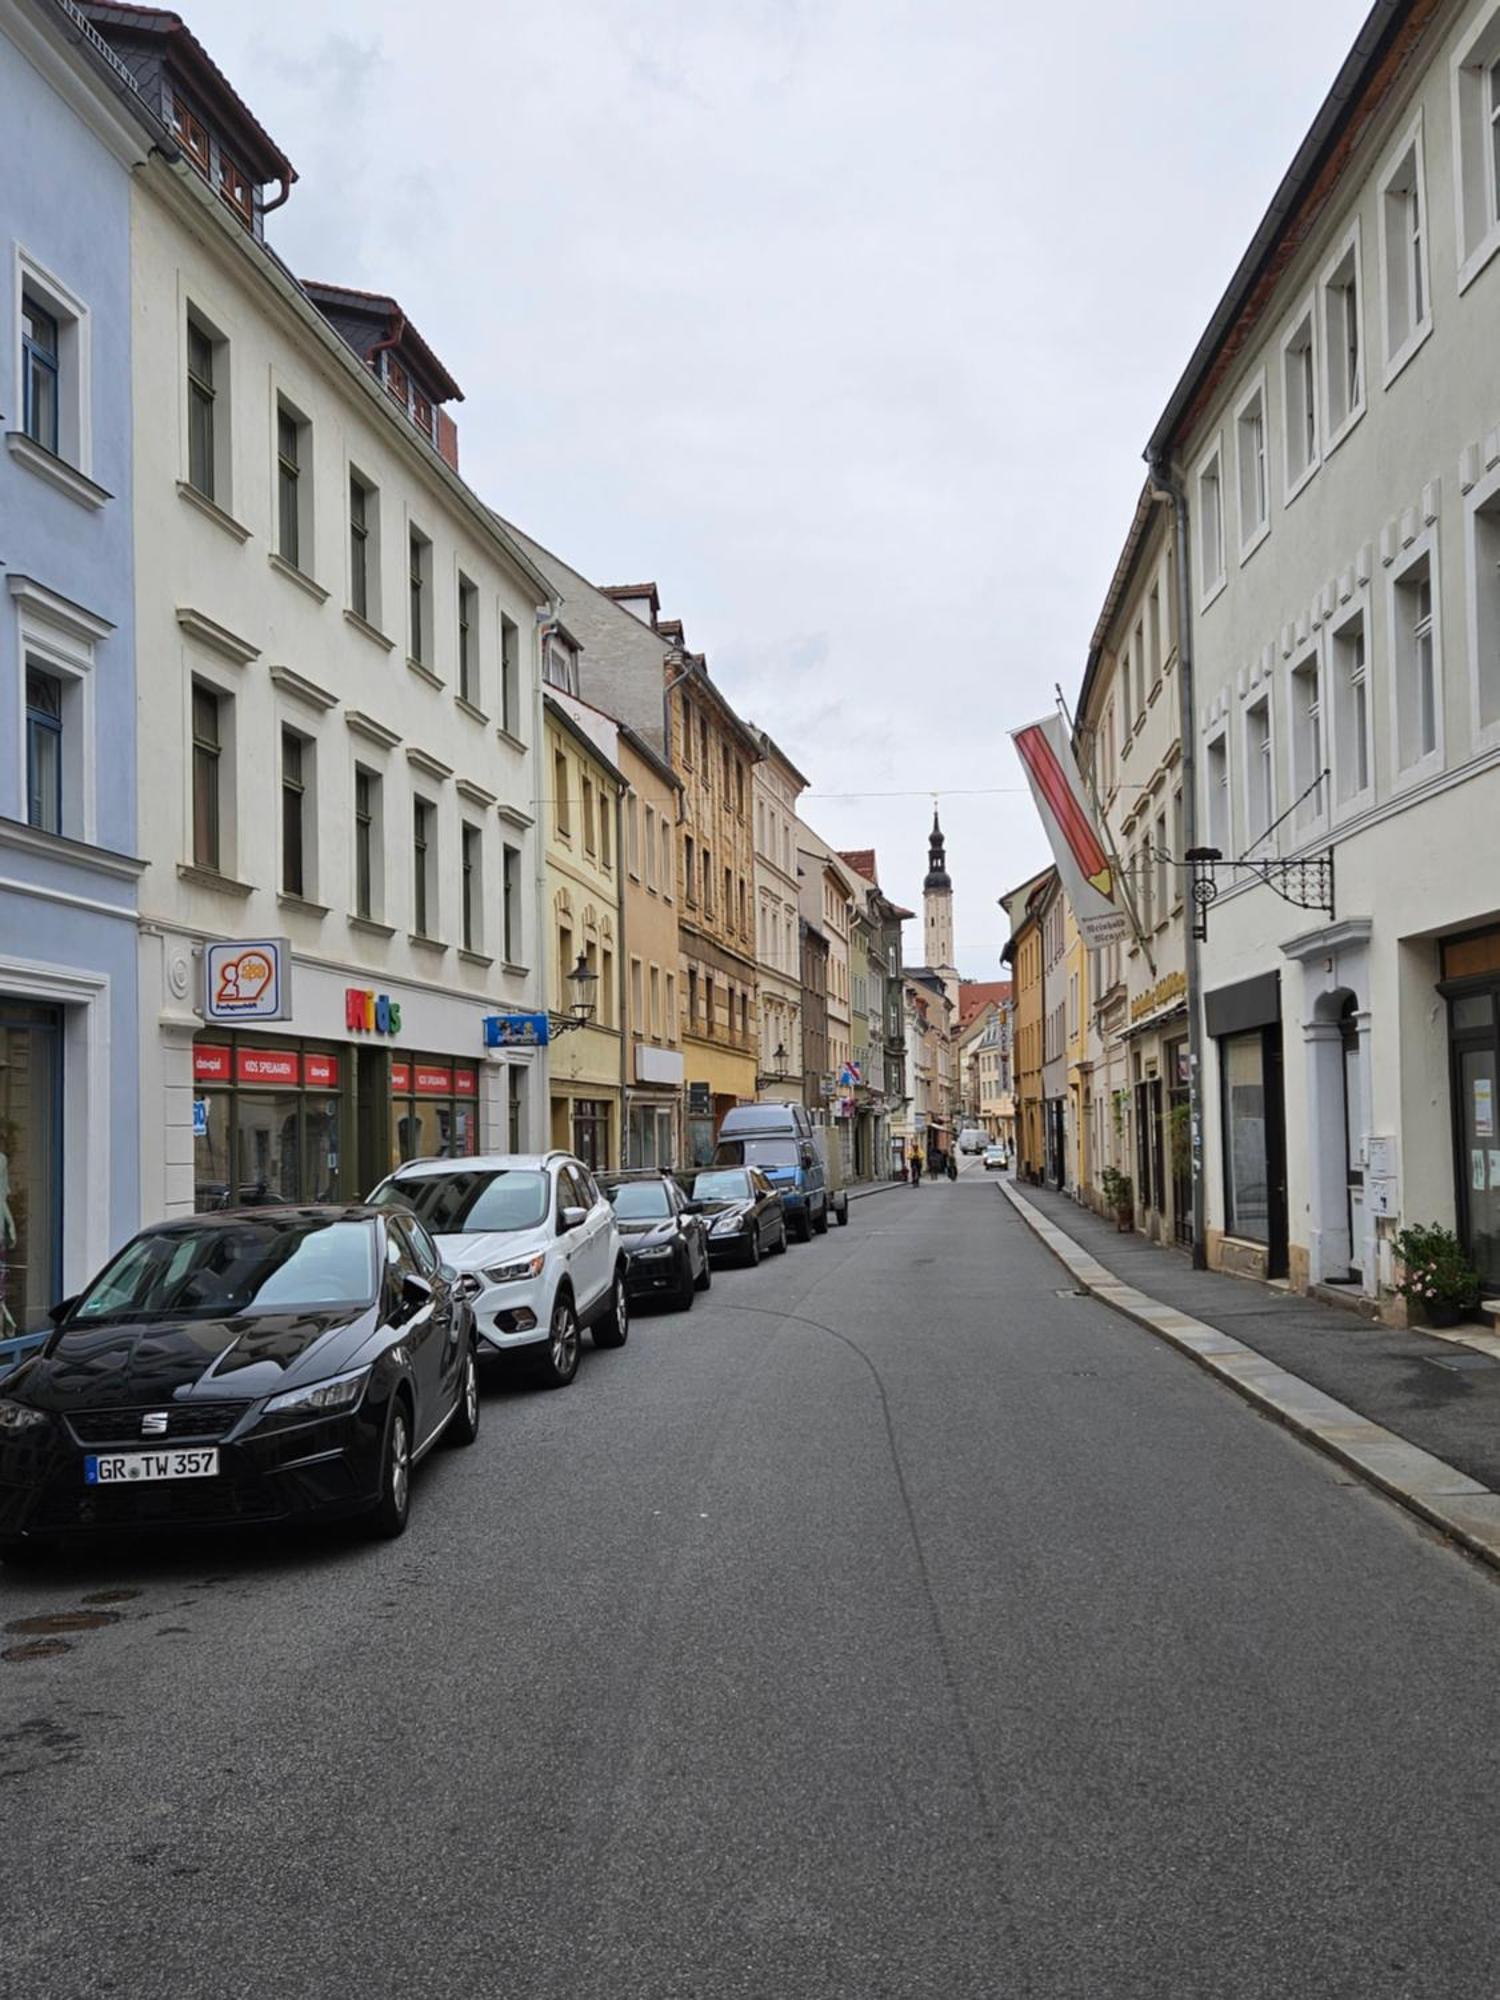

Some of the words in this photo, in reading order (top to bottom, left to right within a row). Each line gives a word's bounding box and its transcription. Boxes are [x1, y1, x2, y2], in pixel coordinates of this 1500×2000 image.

[99, 1458, 126, 1480] GR
[141, 1455, 169, 1477] TW
[174, 1452, 214, 1475] 357
